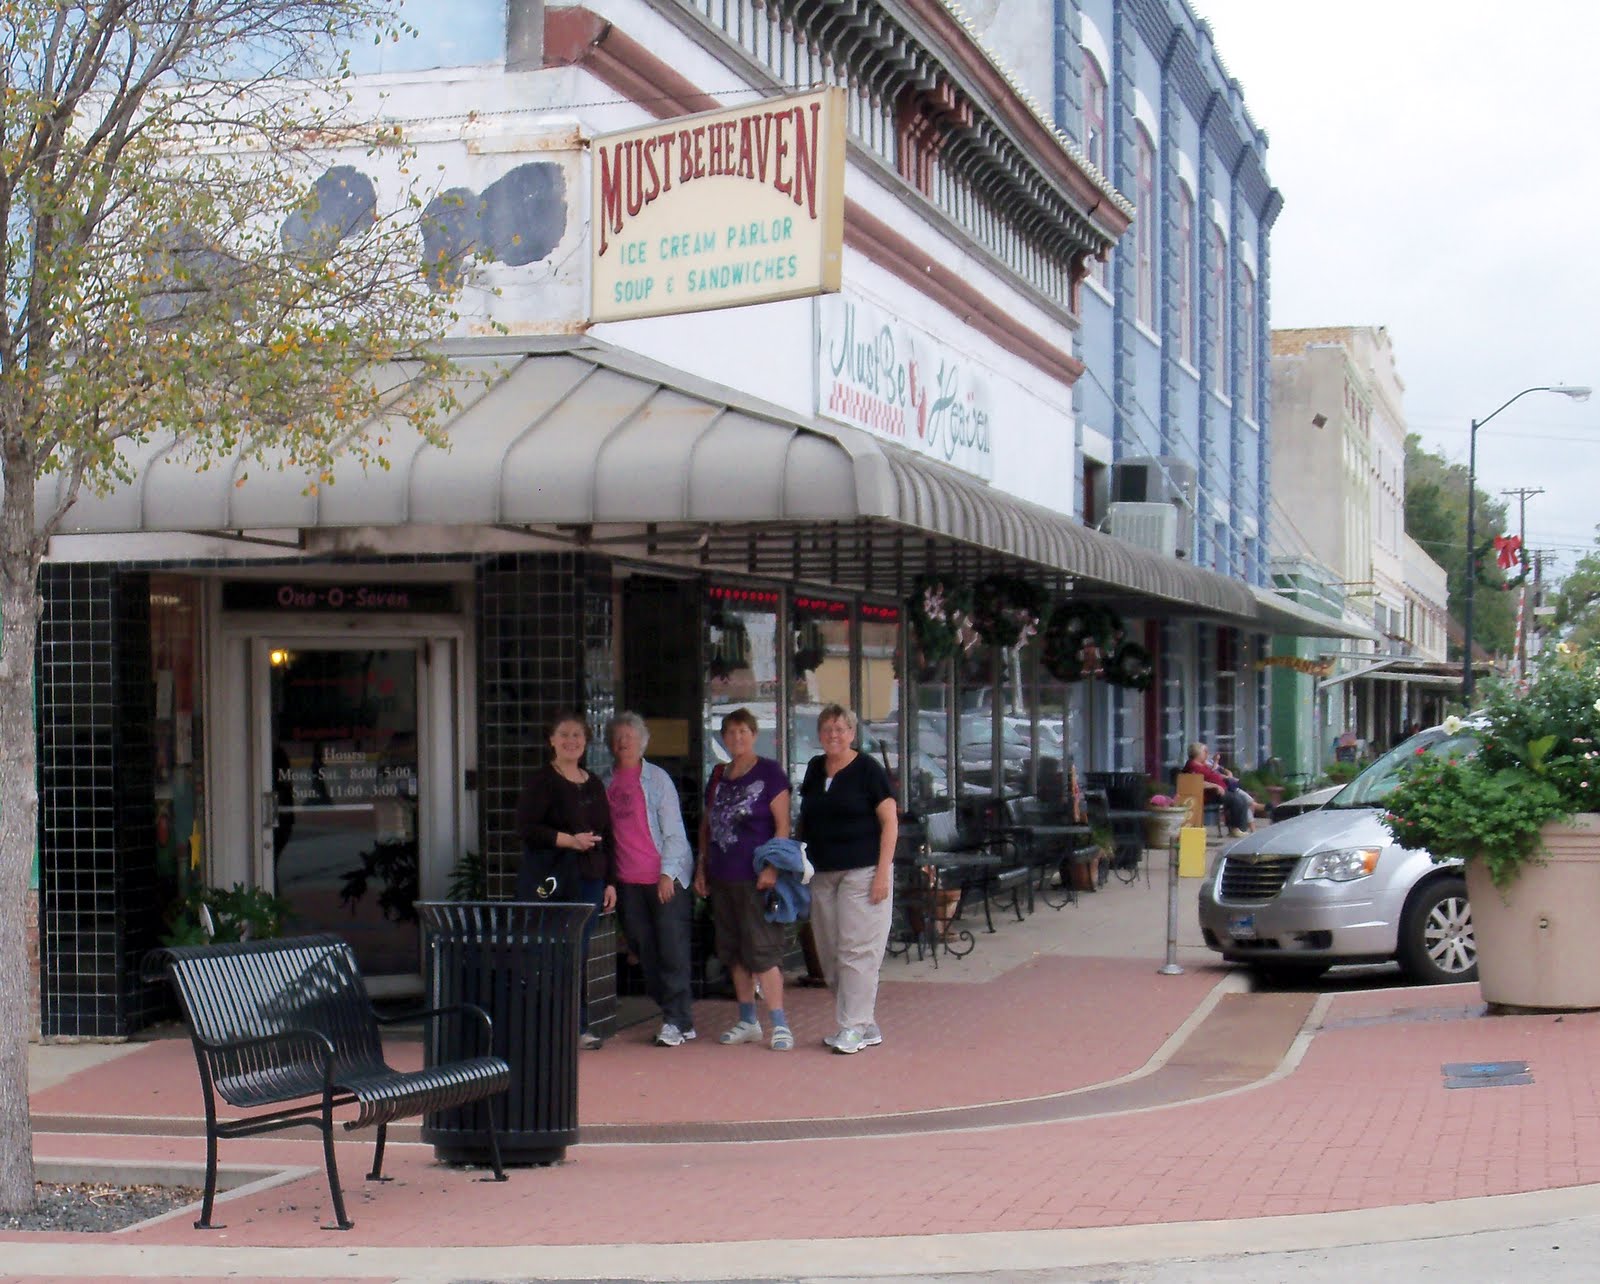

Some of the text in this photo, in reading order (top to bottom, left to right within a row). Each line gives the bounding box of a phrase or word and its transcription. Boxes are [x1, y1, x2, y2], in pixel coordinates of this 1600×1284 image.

[620, 216, 793, 265] ICE CREAM PARLOR
[614, 277, 654, 303] SOUP
[687, 255, 798, 293] SANDWICHES
[830, 302, 880, 395] Must
